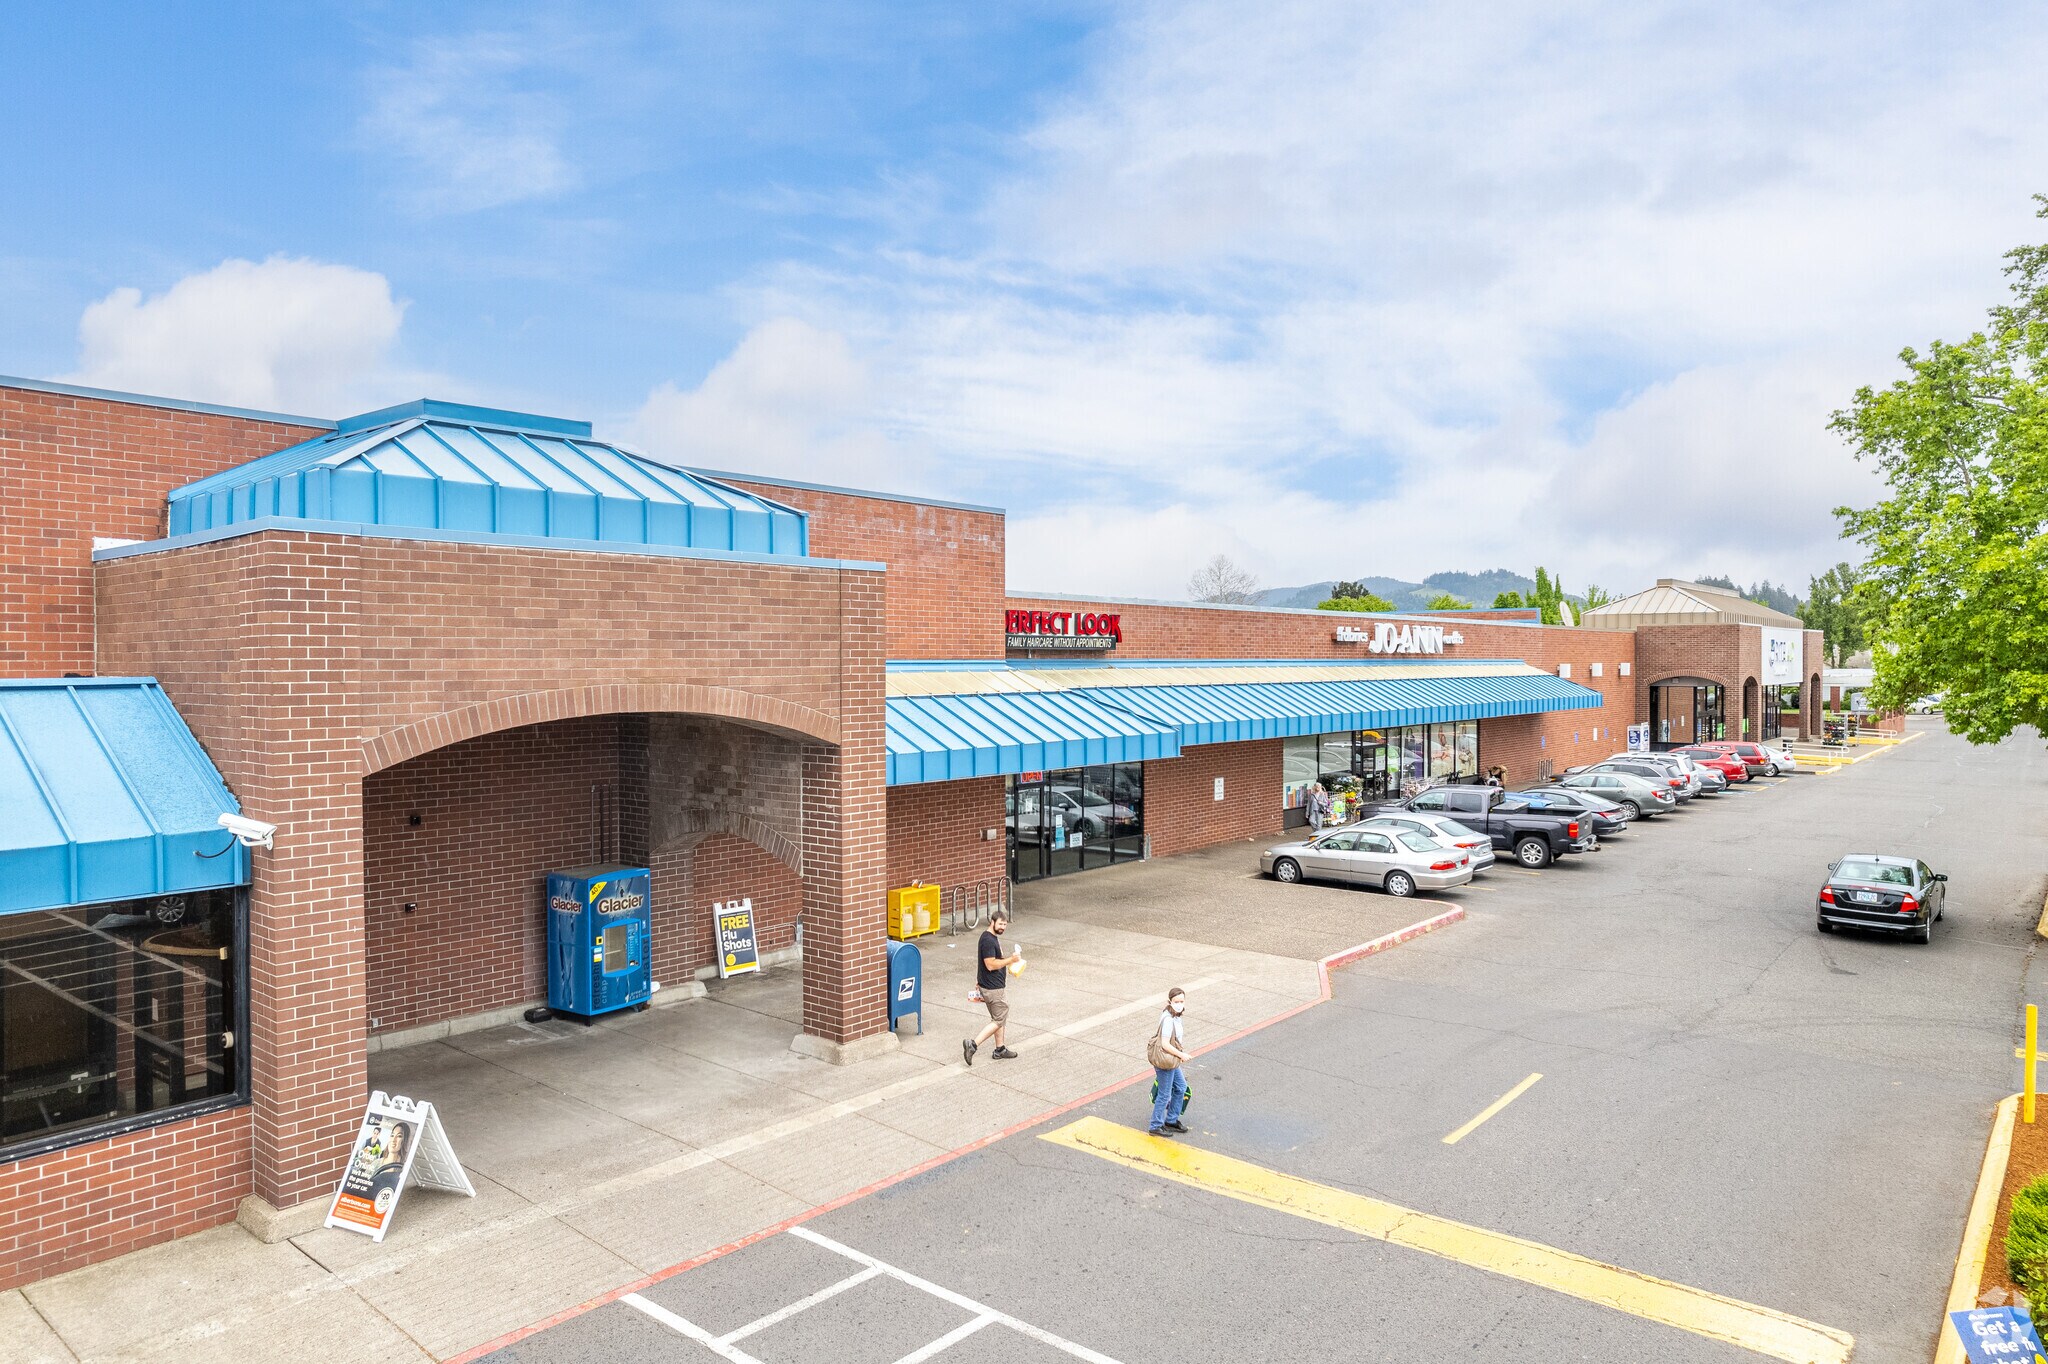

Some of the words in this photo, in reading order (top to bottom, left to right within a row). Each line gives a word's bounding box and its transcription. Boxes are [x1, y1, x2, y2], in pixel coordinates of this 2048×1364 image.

[1005, 609, 1072, 635] ERFECT
[1076, 612, 1122, 642] LOOK
[1007, 636, 1027, 647] FAMILY
[1027, 637, 1053, 648] HAIRCARE
[1054, 637, 1076, 648] WITHOUT
[1076, 638, 1112, 649] APPOINTMENTS
[1369, 622, 1444, 654] JOANN
[1021, 771, 1043, 783] OPEN
[551, 897, 582, 913] Glacier
[598, 894, 643, 914] Glacier
[721, 914, 750, 930] FREE
[722, 930, 738, 941] Flu
[724, 938, 752, 951] Shots
[351, 1182, 361, 1190] your
[1972, 1320, 2008, 1336] Get
[2009, 1321, 2021, 1333] a
[1980, 1340, 2019, 1355] free
[2021, 1336, 2037, 1352] flu
